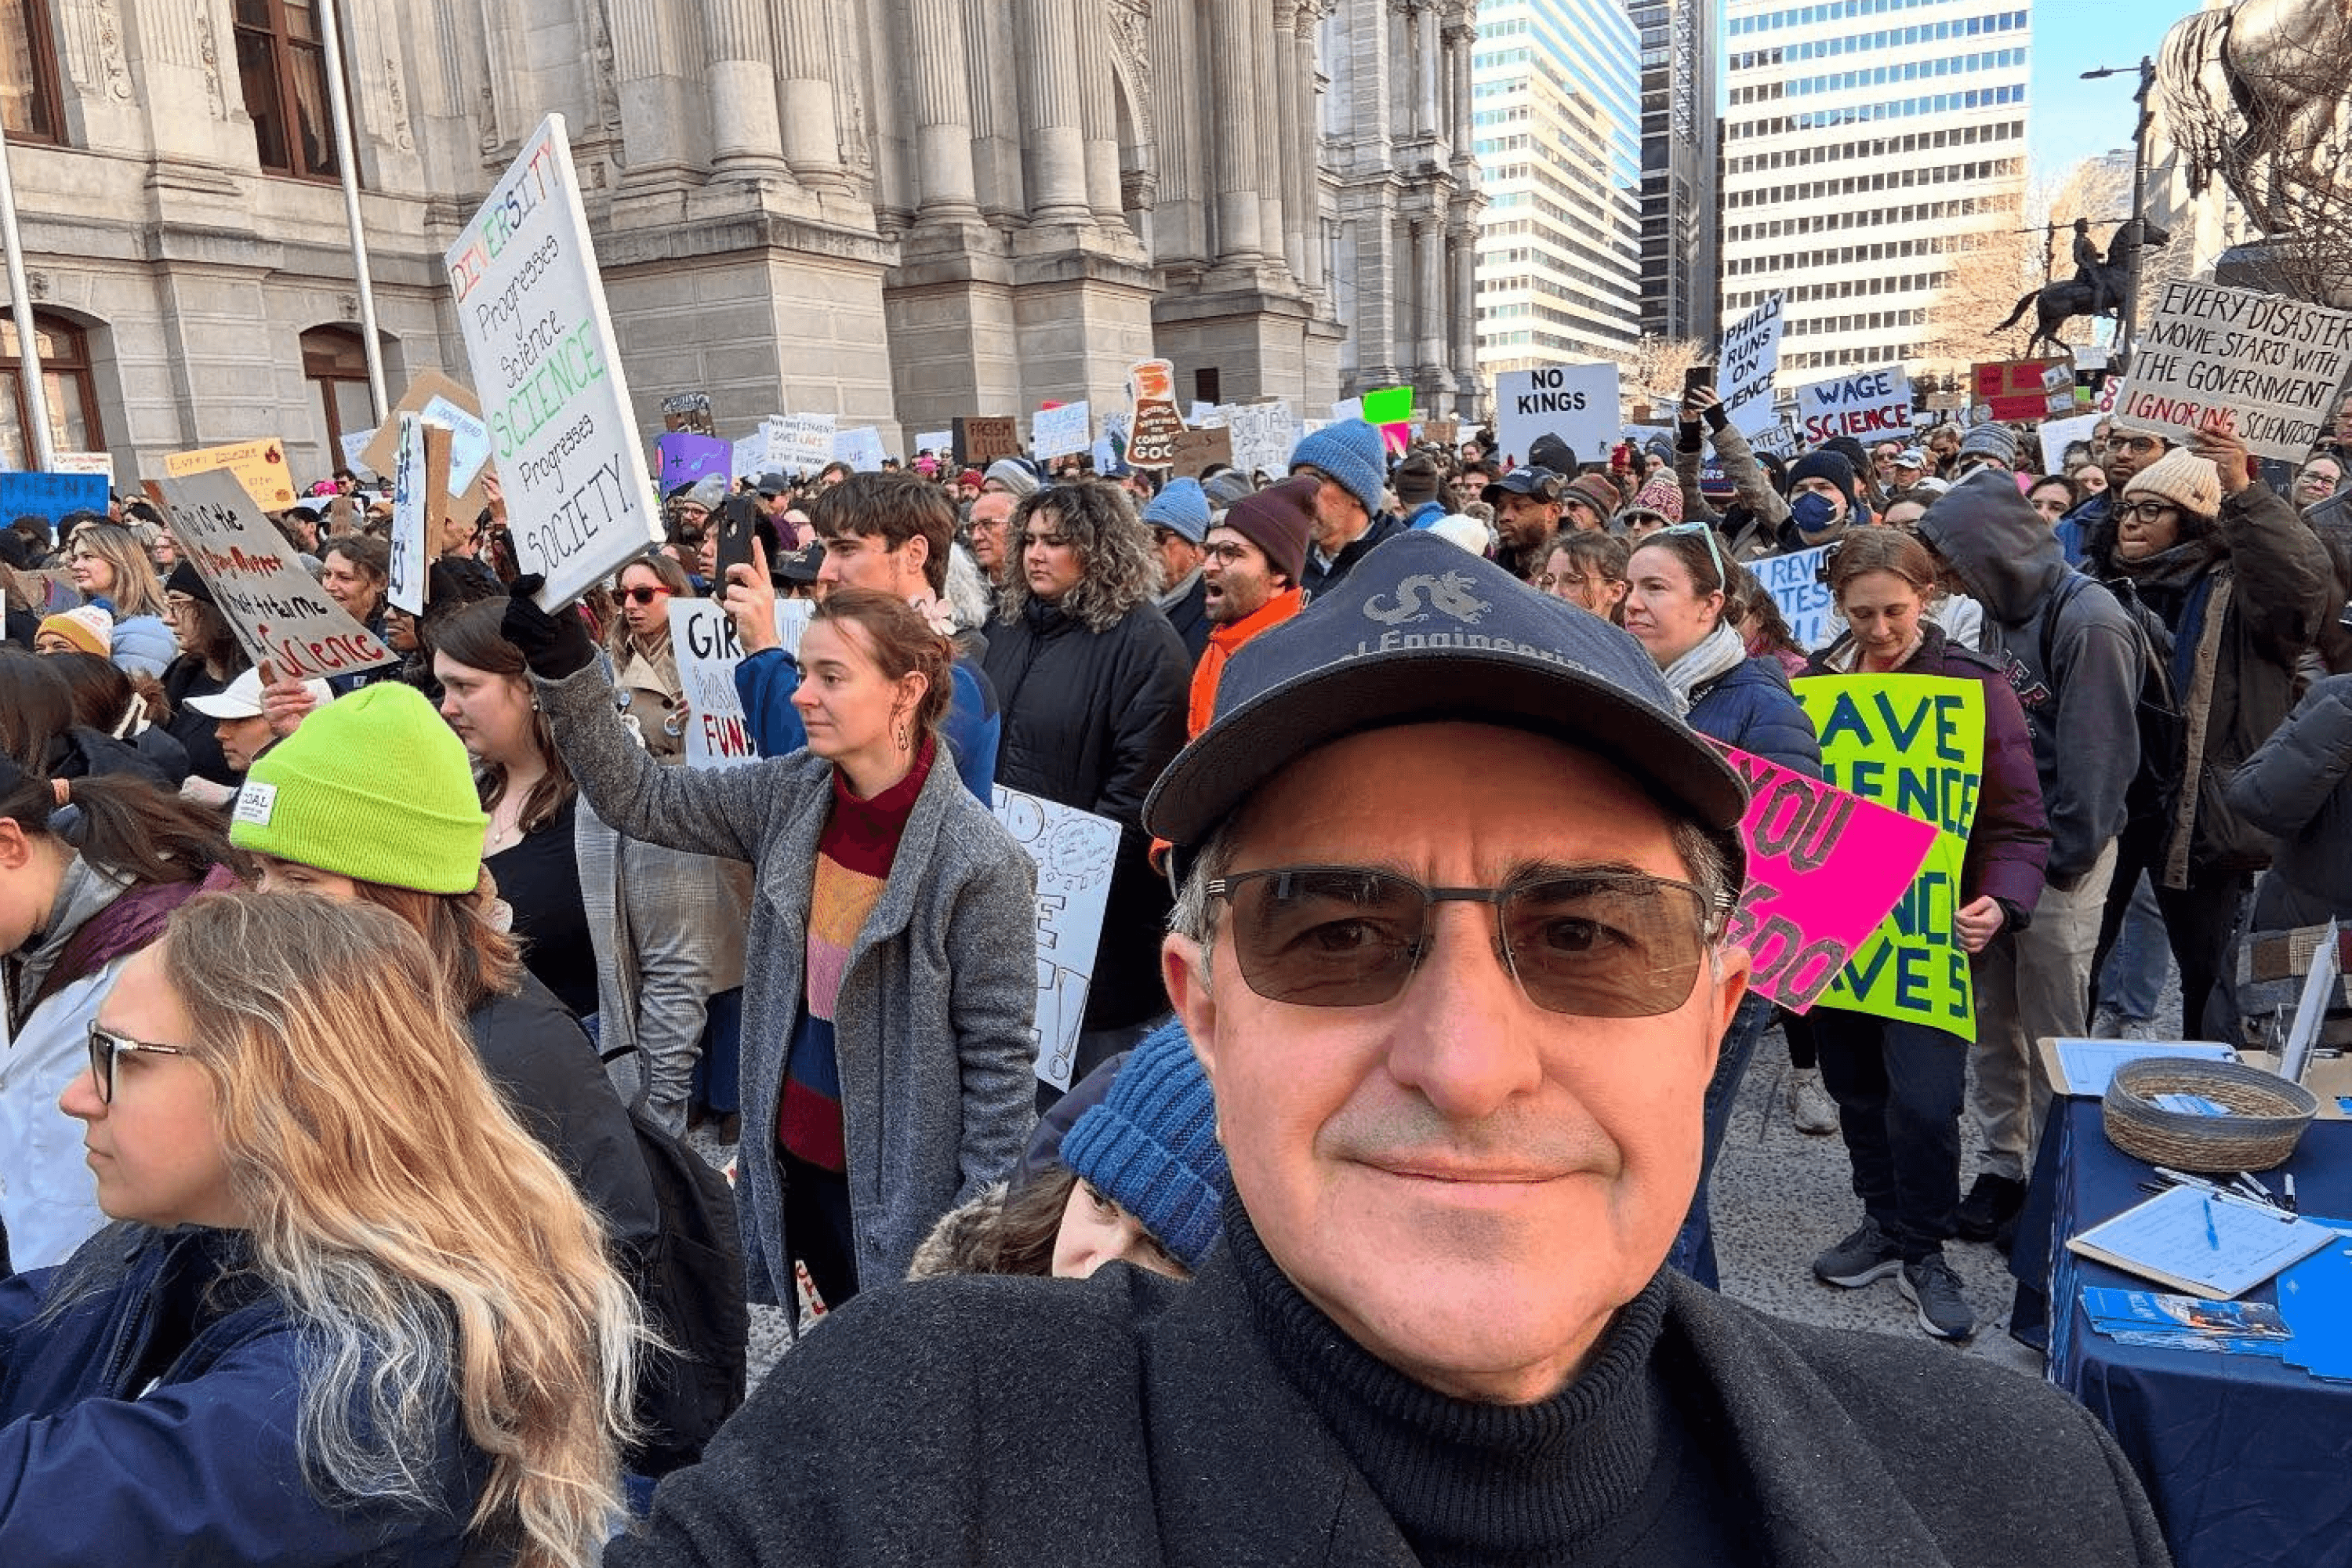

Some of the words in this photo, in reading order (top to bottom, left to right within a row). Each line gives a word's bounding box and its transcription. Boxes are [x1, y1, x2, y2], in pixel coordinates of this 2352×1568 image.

[452, 140, 557, 303] DIVERSITY
[476, 234, 559, 341] Progresses
[1725, 292, 1783, 347] PHILLY
[2161, 283, 2249, 322] EVERY
[2247, 299, 2352, 350] DISASTER
[1726, 327, 1771, 368] RUNS
[1733, 354, 1759, 383] ON
[2148, 320, 2218, 354] MOVIE
[2219, 332, 2290, 366] STARTS
[2292, 348, 2339, 377] WITH
[494, 319, 603, 458] SCIENCE
[1518, 392, 1586, 414] KINGS
[1532, 368, 1563, 390] NO
[1723, 368, 1777, 414] CIENCE
[1815, 372, 1893, 405] WAGE
[2135, 351, 2183, 382] THE
[2187, 361, 2336, 408] GOVERNMENT
[1806, 403, 1912, 444] SCIENCE
[2125, 390, 2238, 431] IGNORING
[519, 414, 593, 493] Progresses
[1771, 583, 1831, 615] TES
[1795, 690, 1965, 763] AVE
[1823, 760, 1980, 840] ENCE
[1830, 935, 1969, 1020] VES
